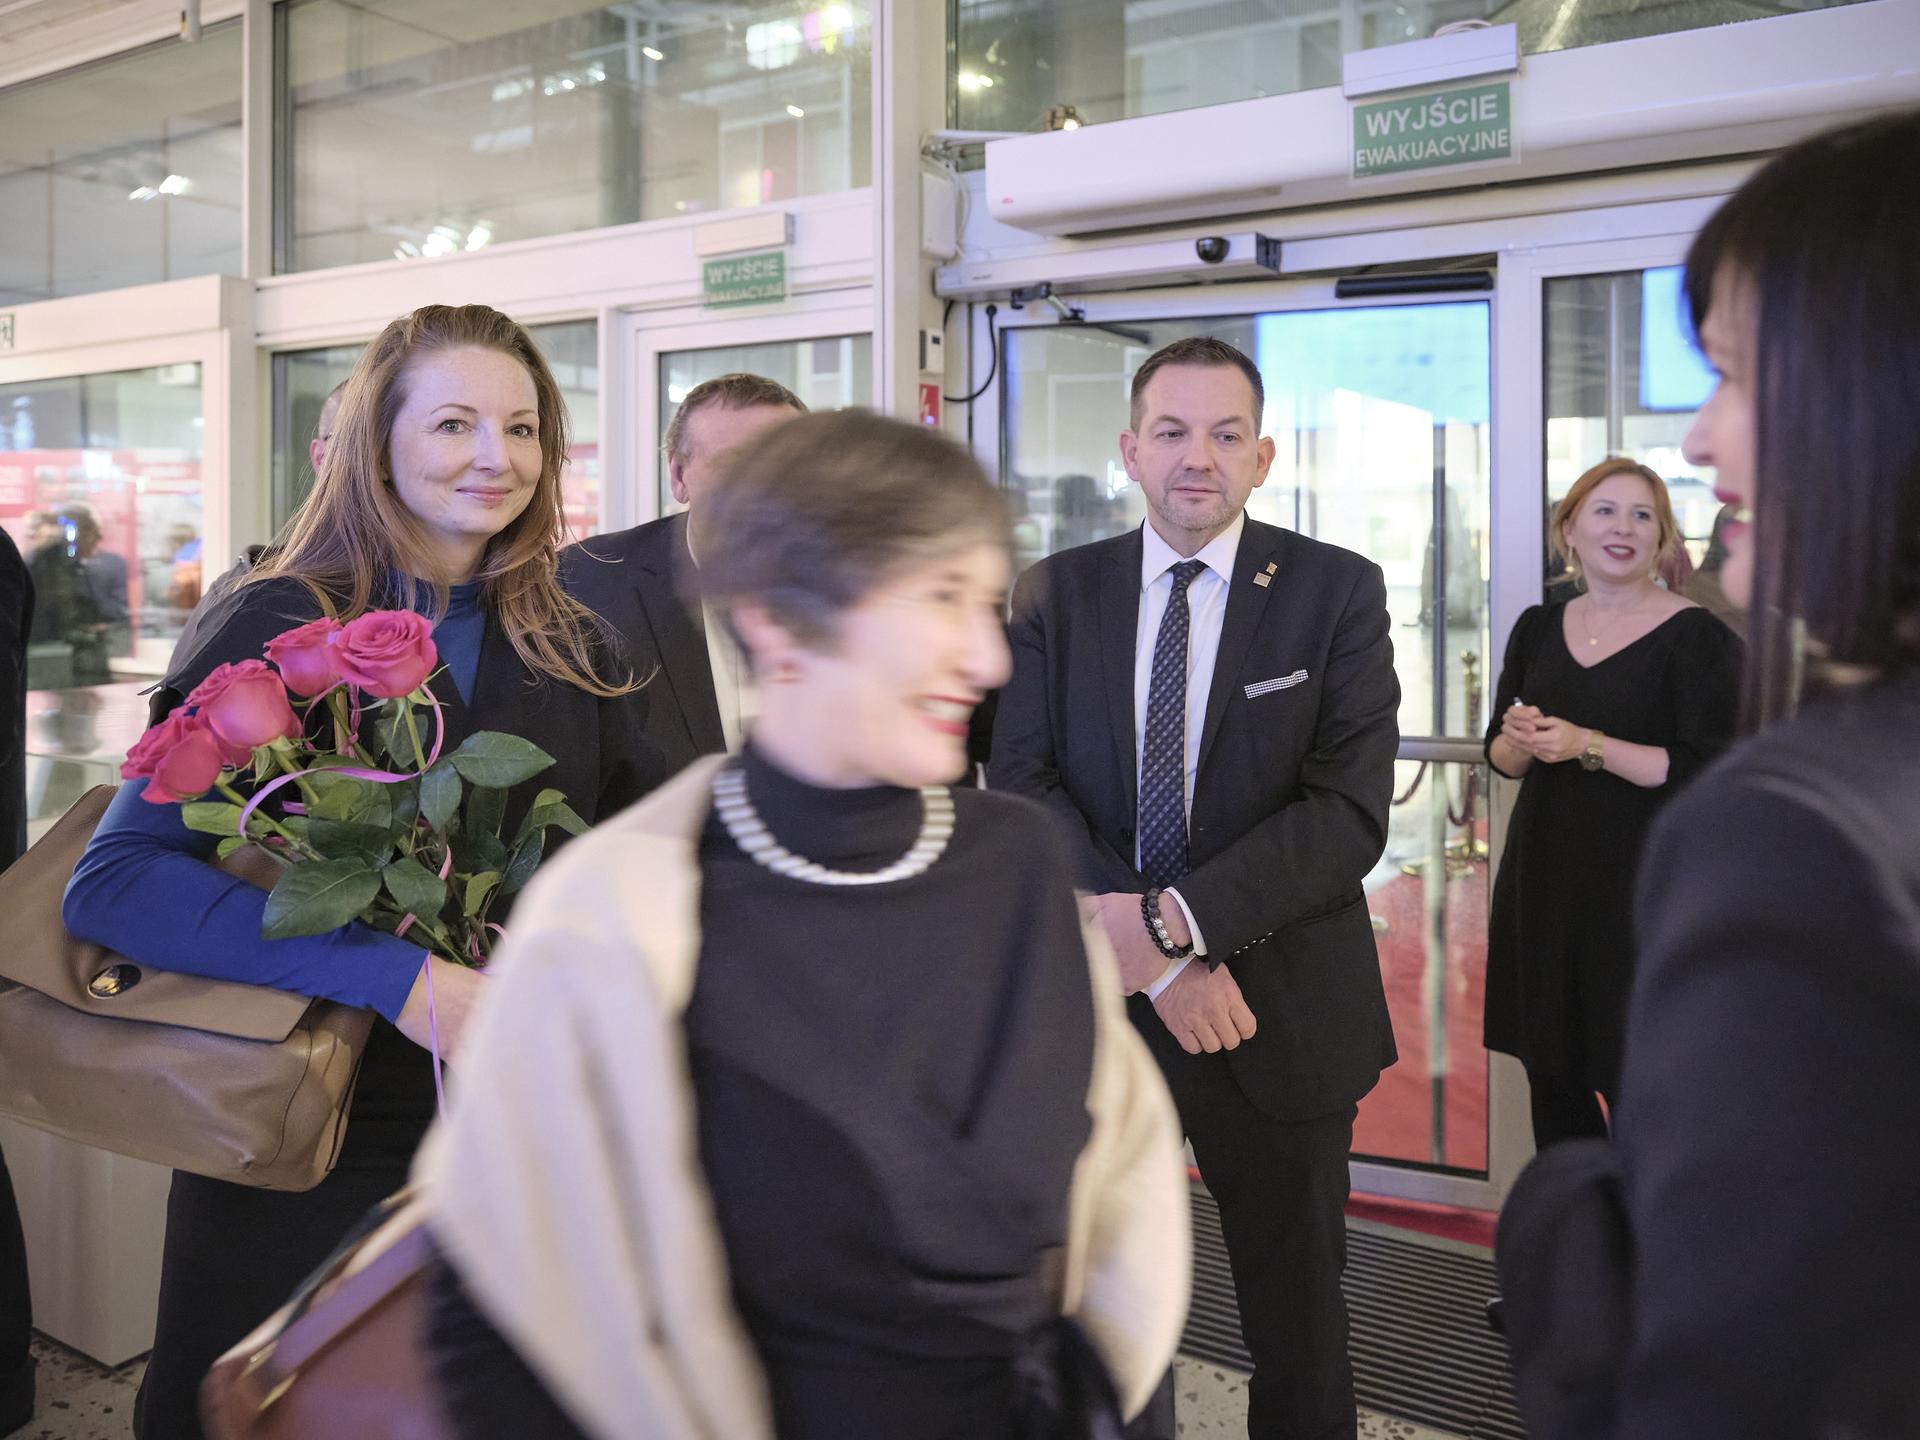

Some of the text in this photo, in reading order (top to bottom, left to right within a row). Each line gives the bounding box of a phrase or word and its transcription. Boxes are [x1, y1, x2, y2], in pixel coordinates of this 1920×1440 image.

[1365, 94, 1498, 137] WYJŚCIE
[1355, 128, 1508, 168] EWAKUACYJNE
[707, 258, 778, 284] WYJŚCIE
